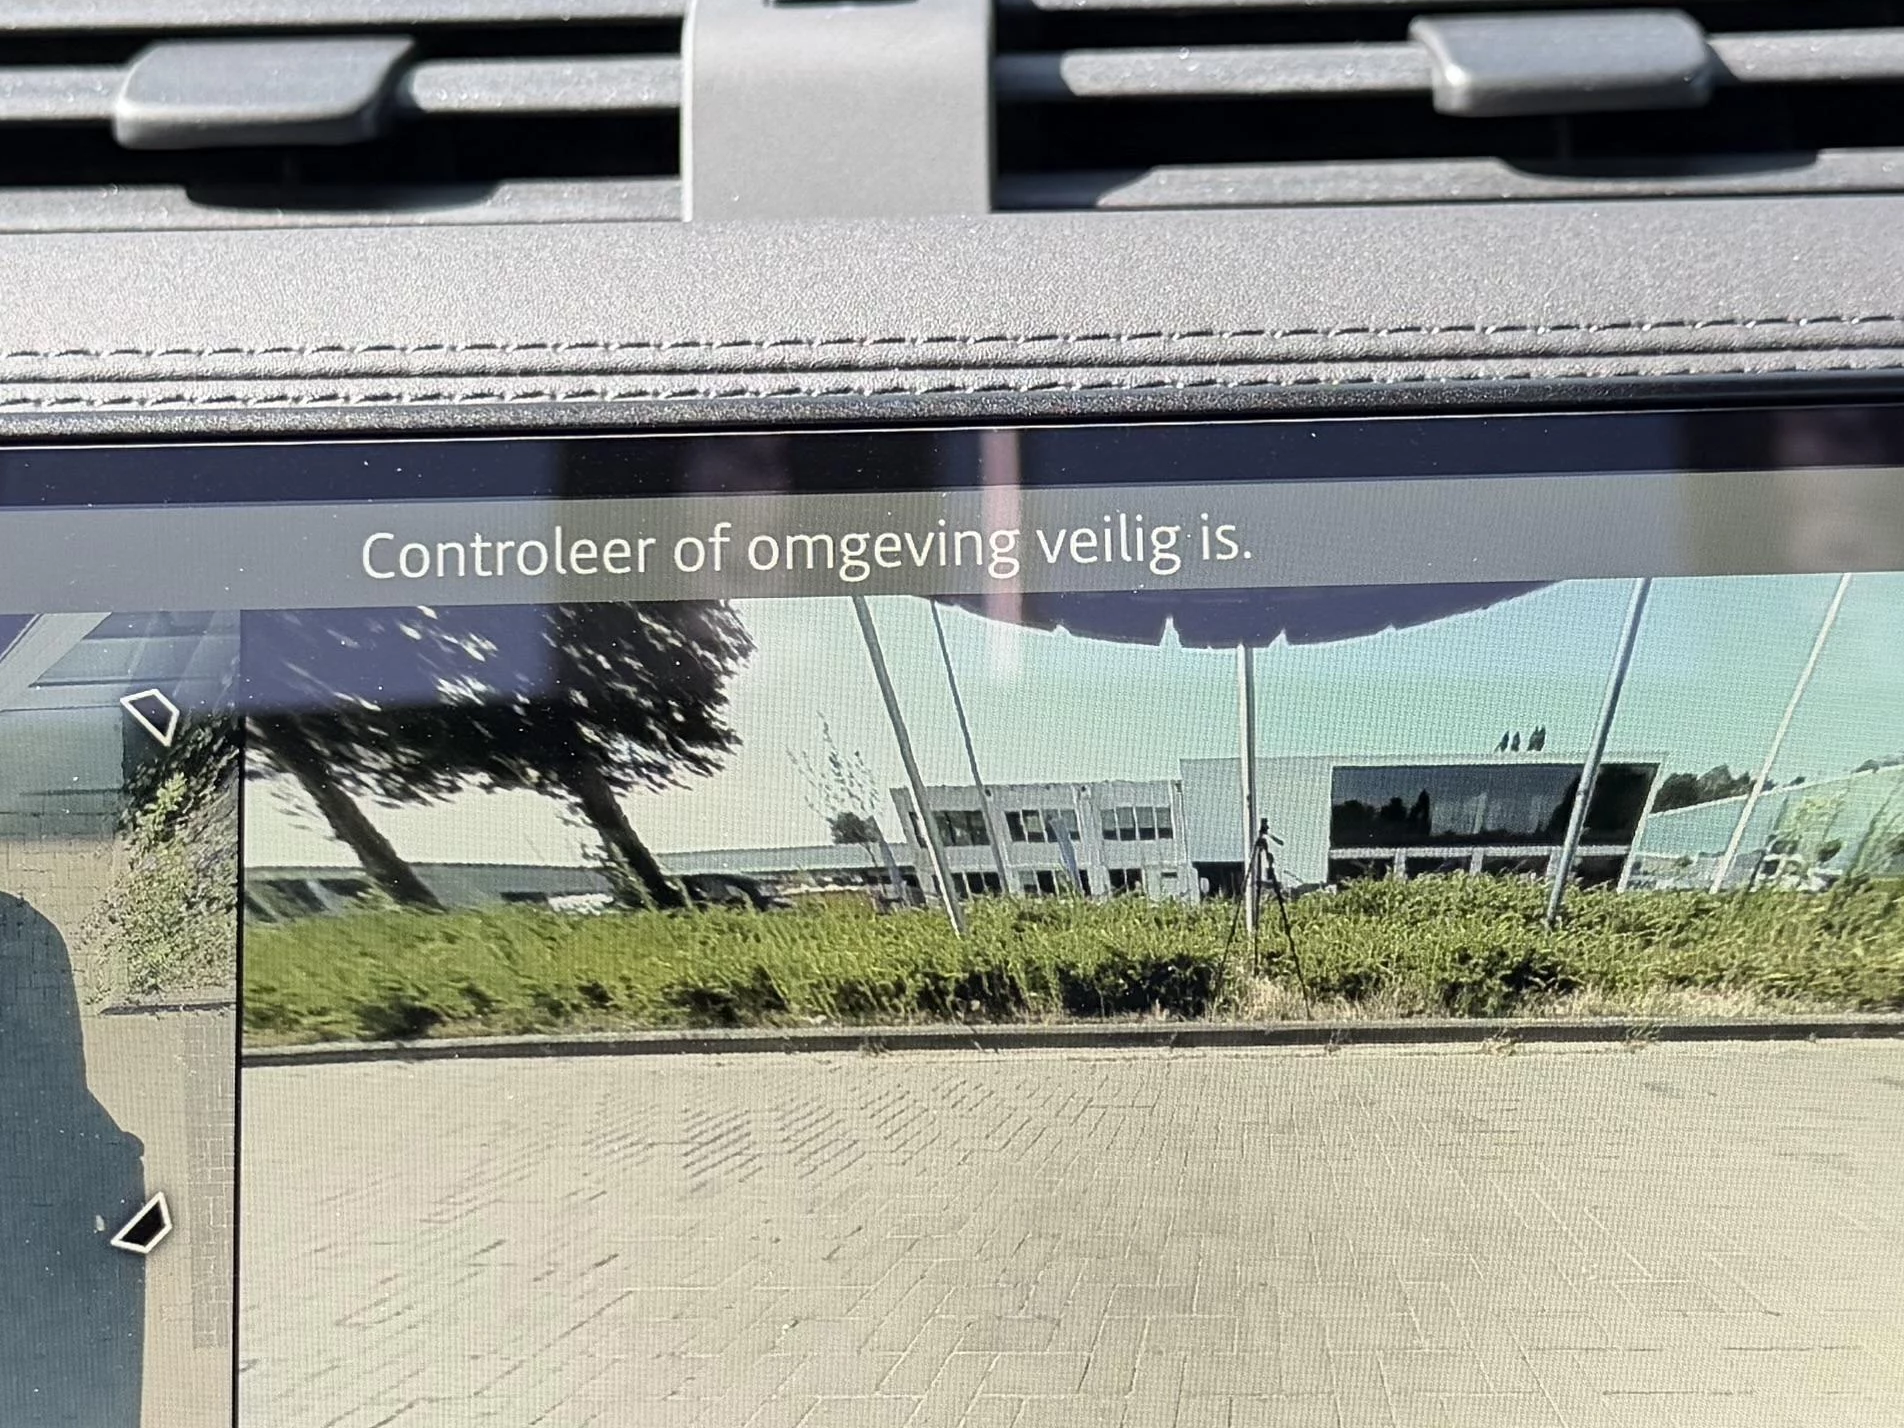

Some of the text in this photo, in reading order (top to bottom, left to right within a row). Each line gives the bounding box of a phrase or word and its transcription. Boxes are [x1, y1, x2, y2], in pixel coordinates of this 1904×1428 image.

[362, 512, 1253, 582] Controleer of omgeving veilig is.
